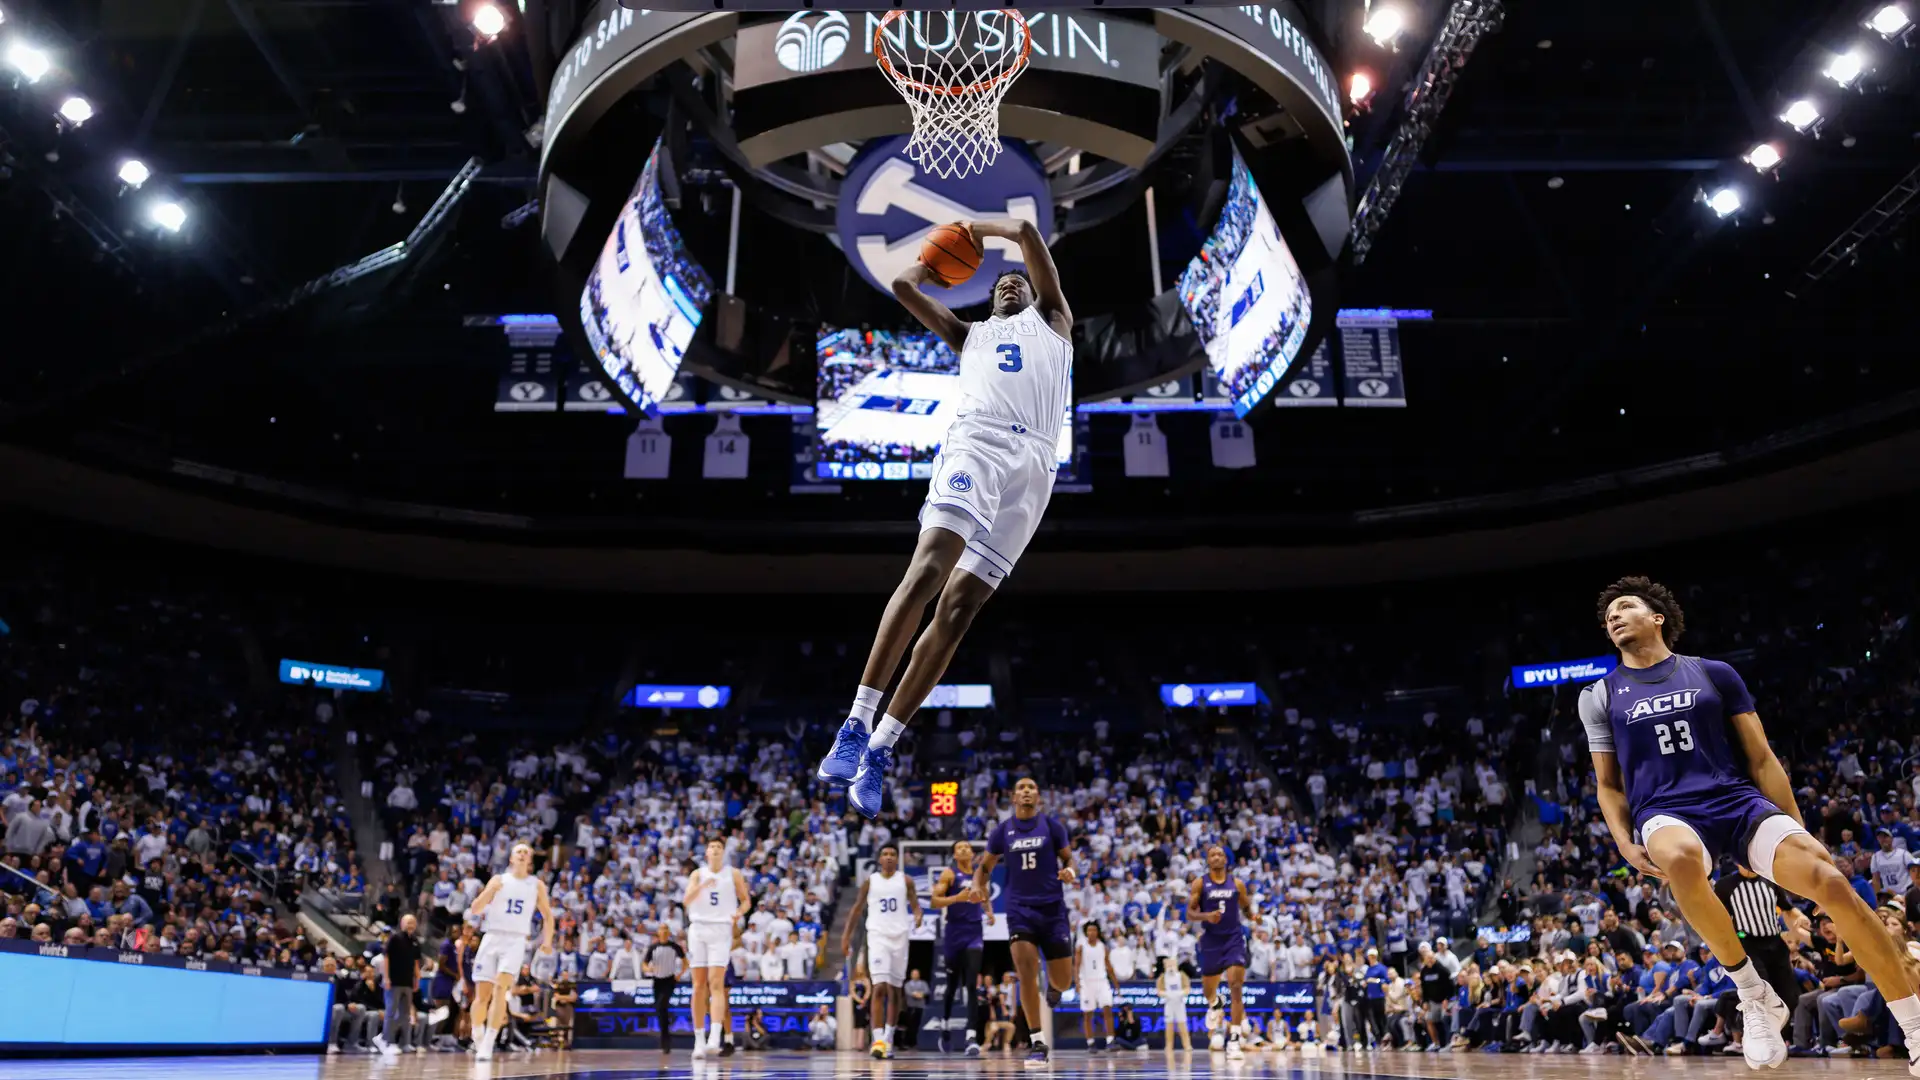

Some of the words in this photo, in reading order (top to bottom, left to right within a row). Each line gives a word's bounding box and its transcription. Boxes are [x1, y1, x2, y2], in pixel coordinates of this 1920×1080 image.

[864, 10, 955, 53] NU
[974, 10, 1108, 63] SKIN
[1269, 7, 1331, 105] OFFICIAL
[996, 343, 1023, 373] 3
[641, 438, 656, 454] 11
[718, 438, 734, 454] 14
[1138, 431, 1151, 445] 11
[1523, 668, 1558, 684] BYU
[1631, 690, 1693, 719] ACU
[1654, 720, 1695, 755] 23
[930, 795, 956, 815] 28
[1011, 838, 1043, 850] ACU
[1021, 852, 1037, 870] 15
[505, 898, 524, 914] 15
[710, 892, 719, 906] 5
[880, 898, 898, 913] 30
[1218, 900, 1226, 914] 5
